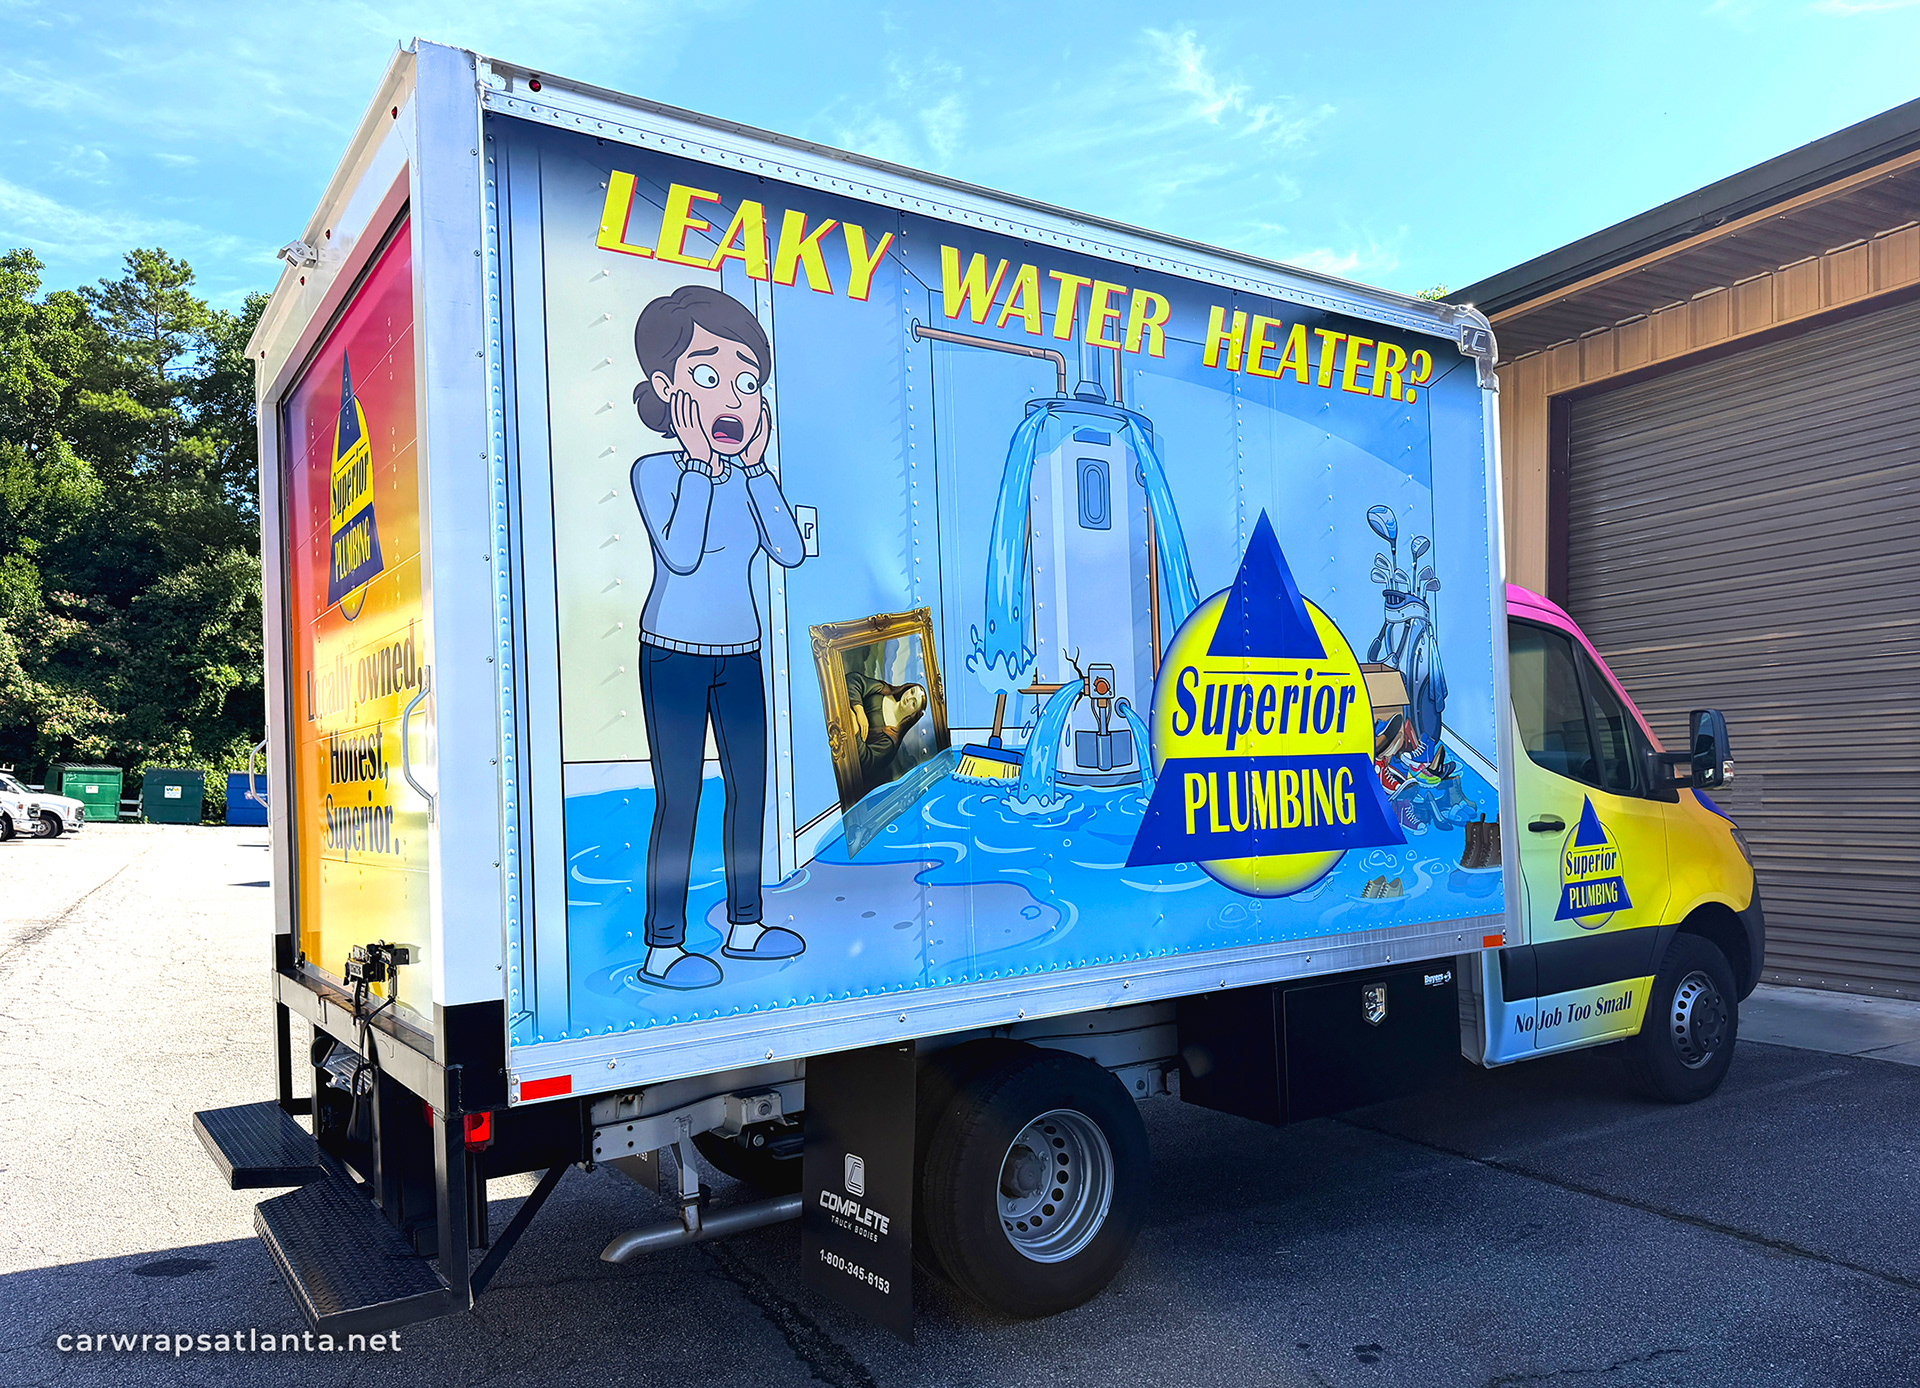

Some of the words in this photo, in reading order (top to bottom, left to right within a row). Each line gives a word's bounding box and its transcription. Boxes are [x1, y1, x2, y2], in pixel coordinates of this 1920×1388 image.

[595, 169, 895, 302] LEAKY
[940, 244, 1171, 359] WATER
[1202, 304, 1434, 404] HEATER?
[332, 447, 370, 523] Superior
[334, 515, 371, 583] PLUMBING
[307, 650, 354, 724] Locally
[357, 617, 423, 705] owned,
[1171, 665, 1356, 751] Superior
[329, 719, 389, 791] Honest,
[326, 789, 401, 864] Superior.
[1183, 766, 1357, 835] PLUMBING
[1565, 846, 1617, 880] Superior
[1569, 881, 1618, 910] PLUMBING
[1513, 1012, 1534, 1035] No
[1537, 1006, 1562, 1031] Job
[1567, 1002, 1592, 1024] Too
[1594, 990, 1633, 1017] Small
[820, 1190, 890, 1235] COMPLETE
[831, 1215, 852, 1230] TRUCK
[854, 1225, 878, 1243] BODIES
[820, 1249, 890, 1294] 1-800-345-6153
